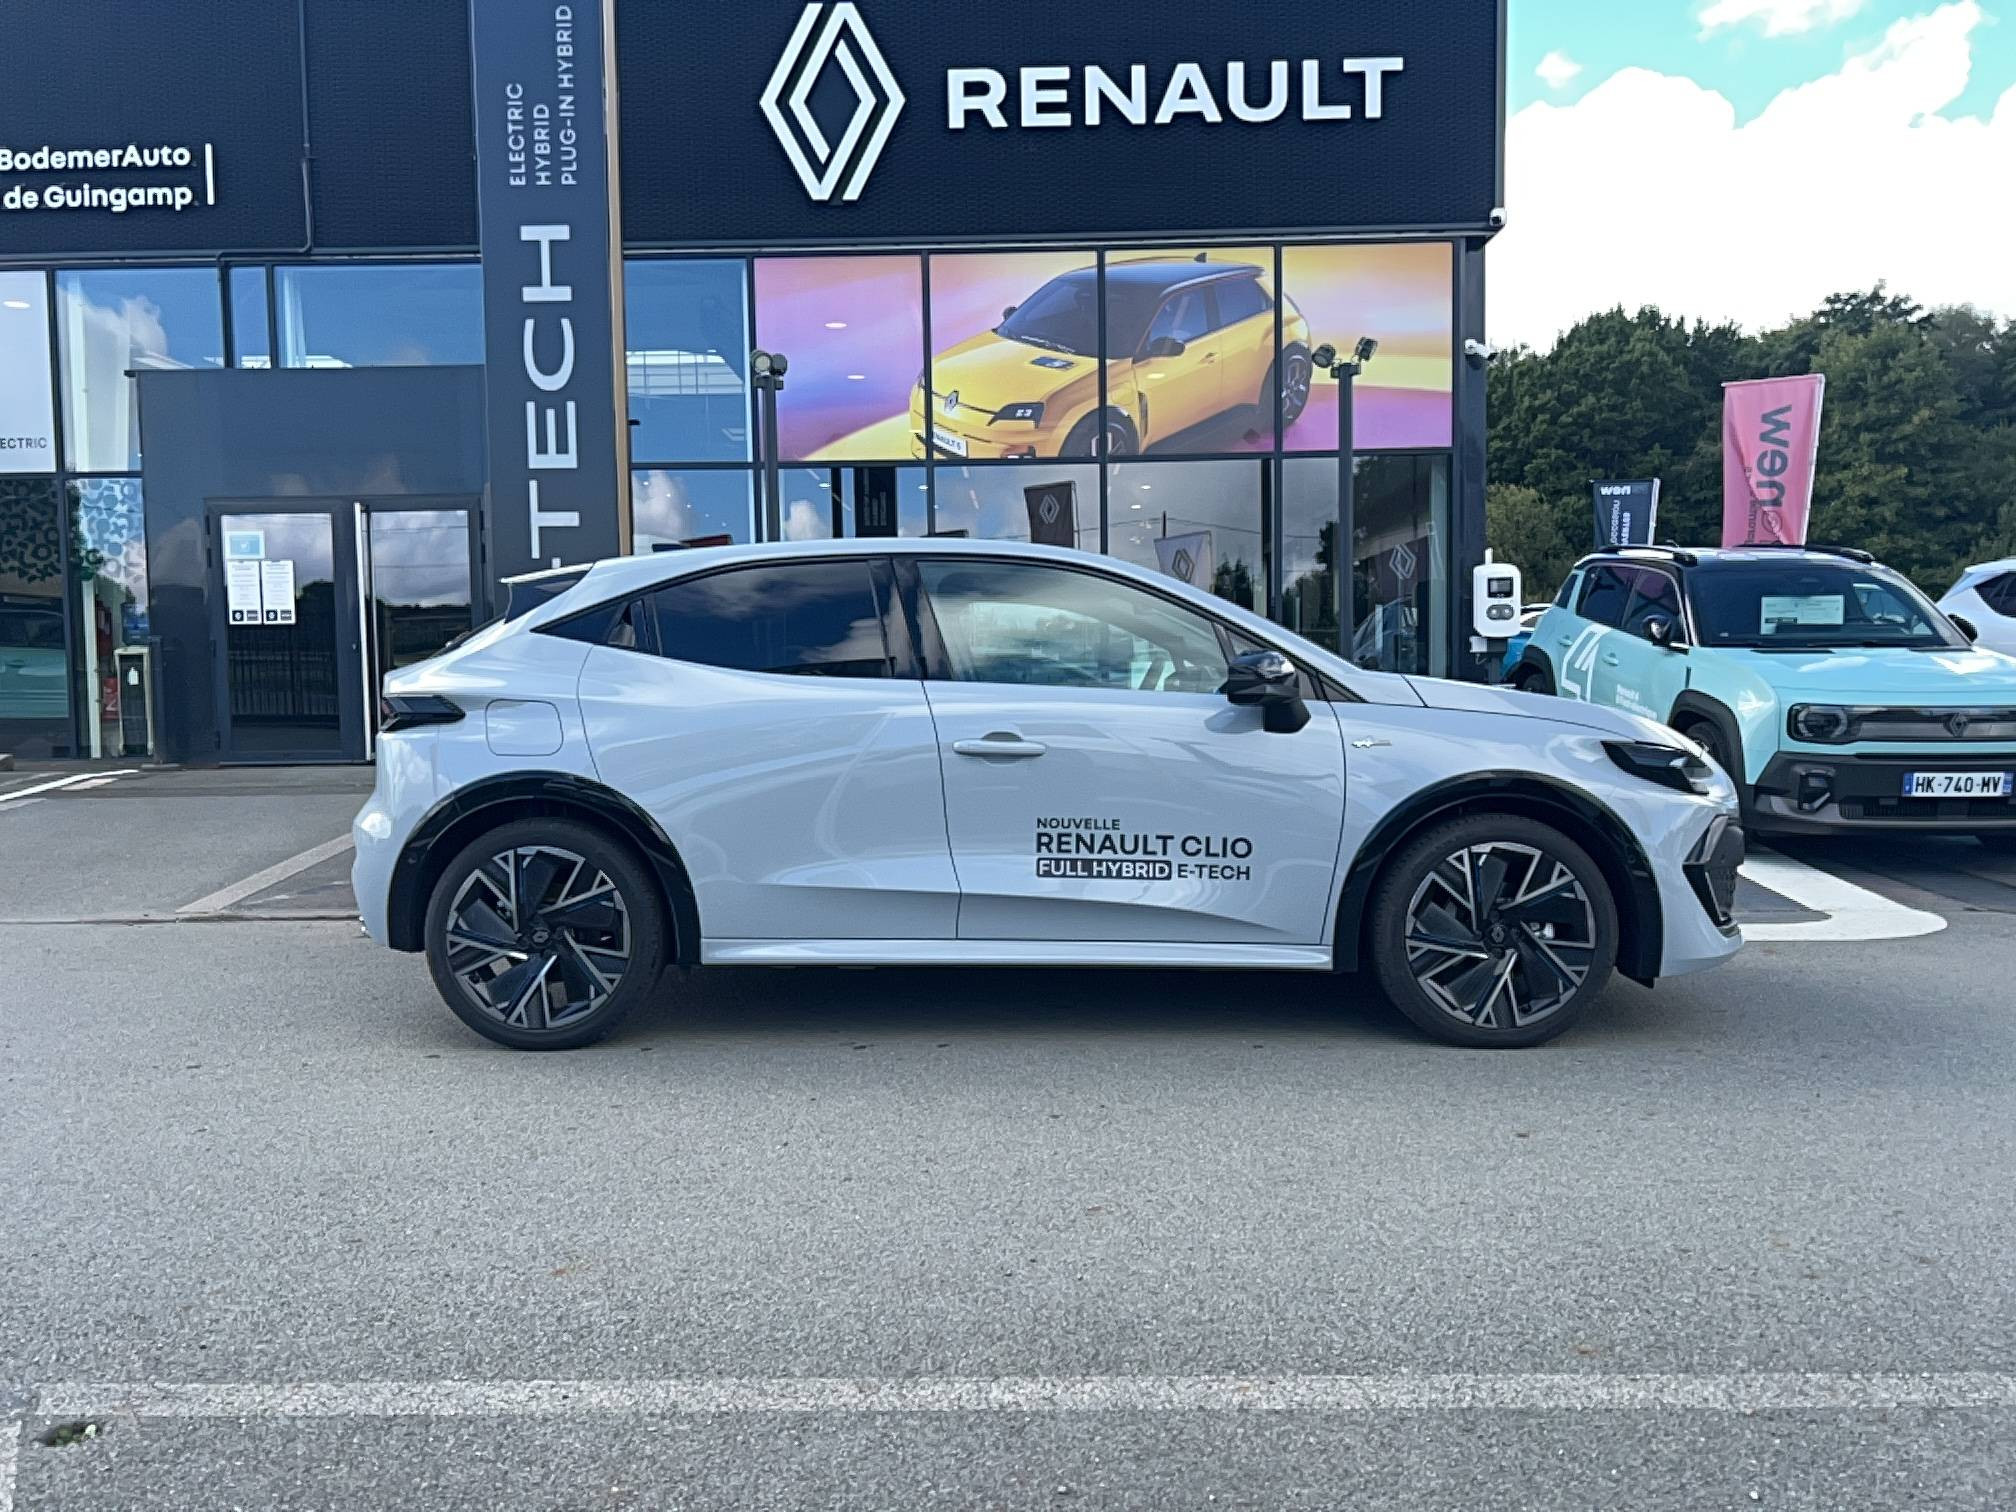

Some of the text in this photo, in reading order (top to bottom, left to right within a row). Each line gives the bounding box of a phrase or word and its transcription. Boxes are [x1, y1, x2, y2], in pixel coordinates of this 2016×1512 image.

[555, 4, 577, 185] PLUG-IN HYBRID
[946, 56, 1404, 129] RENAULT
[505, 83, 526, 186] ELECTRIC
[533, 103, 552, 186] HYBRID
[0, 144, 191, 171] BodemerAuto
[3, 183, 193, 212] de Guingamp
[0, 437, 47, 449] ECTRIC
[1915, 776, 2001, 793] HK-740-MV
[1036, 817, 1121, 831] NOUVELLE
[1036, 832, 1253, 859] RENAULT CLIO
[1038, 859, 1250, 881] FULL HYBRID E-TECH
